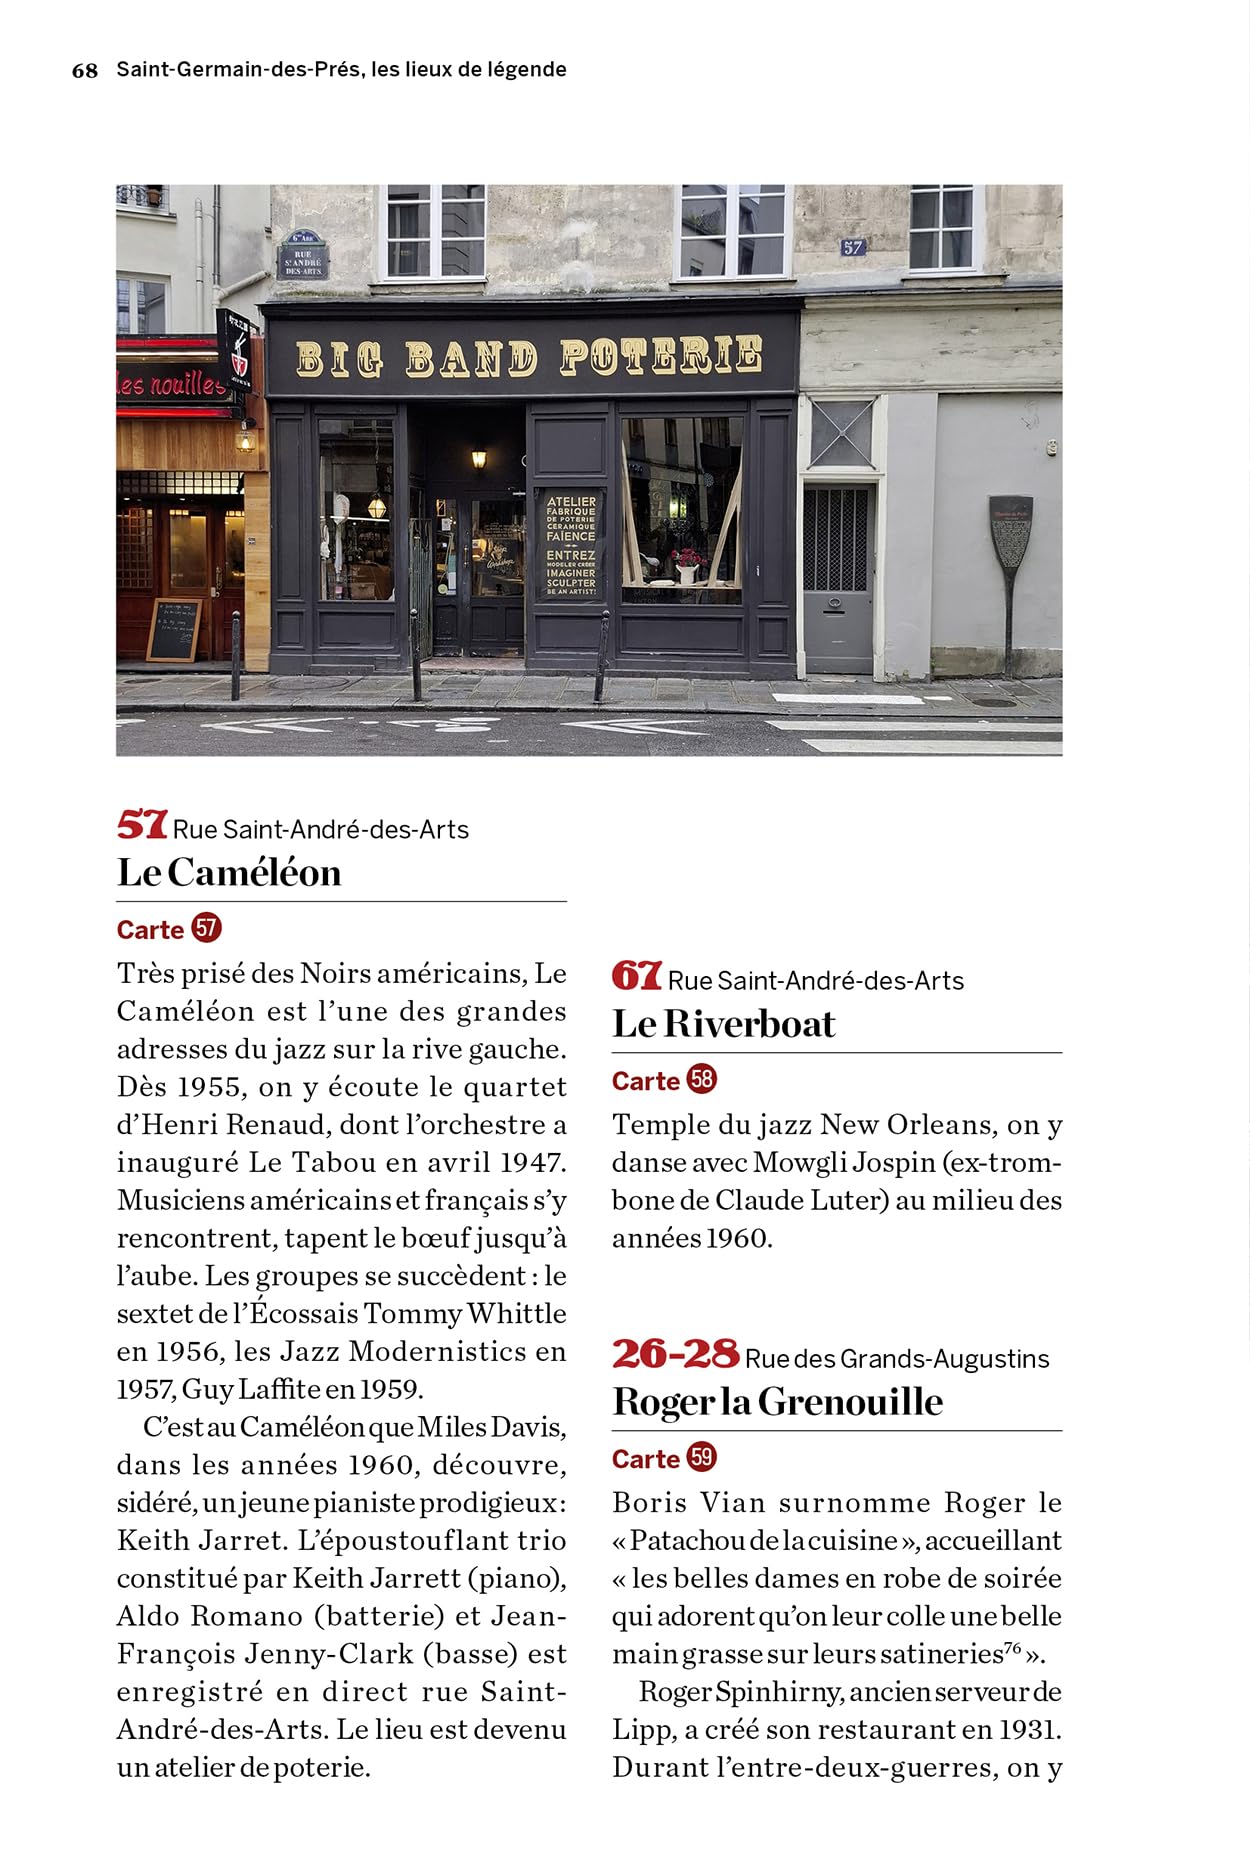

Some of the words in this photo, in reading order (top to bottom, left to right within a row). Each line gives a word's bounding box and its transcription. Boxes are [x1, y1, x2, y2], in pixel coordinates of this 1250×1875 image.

[72, 63, 98, 78] 68
[117, 61, 365, 79] Saint-Germain-des-Prés,
[372, 61, 400, 77] les
[406, 61, 452, 77] lieux
[458, 61, 482, 77] de
[489, 61, 566, 80] légende
[844, 241, 861, 255] 57
[293, 258, 321, 266] ANDRÉ
[296, 341, 383, 378] BIG
[405, 340, 538, 378] BAND
[559, 334, 764, 377] POTERIE
[151, 369, 226, 395] nouilles
[547, 497, 596, 506] ATELIER
[547, 531, 595, 541] FAÏENCE
[547, 551, 595, 560] ENTREZ
[547, 579, 595, 587] SCULPTER
[117, 808, 168, 839] 57
[174, 819, 217, 839] Rue
[224, 819, 469, 839] Saint-André-des-Arts
[117, 858, 161, 886] Le
[168, 855, 341, 887] Caméléon
[117, 920, 184, 939] Carte
[196, 919, 217, 936] 57
[118, 961, 174, 983] Très
[181, 961, 245, 989] prisé
[252, 962, 294, 983] des
[301, 962, 371, 983] Noirs
[378, 961, 527, 987] américains,
[535, 962, 566, 983] Le
[612, 960, 663, 990] 67
[669, 970, 712, 990] Rue
[718, 970, 964, 990] Saint-André-des-Arts
[117, 999, 254, 1021] Caméléon
[268, 1002, 307, 1021] est
[319, 1000, 387, 1021] l’une
[400, 1000, 444, 1021] des
[457, 1000, 566, 1027] grandes
[612, 1009, 656, 1038] Le
[664, 1008, 836, 1038] Riverboat
[612, 1071, 680, 1091] Carte
[691, 1070, 712, 1087] 58
[613, 1113, 710, 1141] Temple
[719, 1113, 751, 1134] du
[757, 1113, 811, 1140] jazz
[821, 1113, 879, 1134] New
[888, 1113, 997, 1139] Orleans,
[1008, 1120, 1040, 1134] on
[1048, 1120, 1063, 1140] y
[613, 1338, 740, 1368] 26-28
[747, 1348, 789, 1368] Rue
[794, 1348, 835, 1368] des
[841, 1348, 1049, 1373] Grands-Augustins
[613, 1387, 716, 1423] Roger
[720, 1386, 752, 1415] la
[759, 1386, 943, 1416] Grenouille
[612, 1449, 680, 1469] Carte
[691, 1448, 712, 1466] 59
[613, 1491, 686, 1512] Boris
[700, 1491, 765, 1512] Vian
[780, 1498, 930, 1512] surnomme
[945, 1491, 1025, 1519] Roger
[1039, 1491, 1061, 1512] le
[117, 1680, 262, 1708] enregistré
[277, 1687, 309, 1702] en
[323, 1680, 407, 1702] direct
[422, 1687, 467, 1702] rue
[482, 1680, 566, 1702] Saint-
[117, 1763, 150, 1777] un
[155, 1755, 235, 1777] atelier
[240, 1756, 269, 1777] de
[274, 1755, 370, 1783] poterie.
[613, 1756, 709, 1777] Durant
[717, 1756, 998, 1783] l’entre-deux-guerres,
[1008, 1763, 1040, 1777] on
[1048, 1763, 1063, 1783] y
